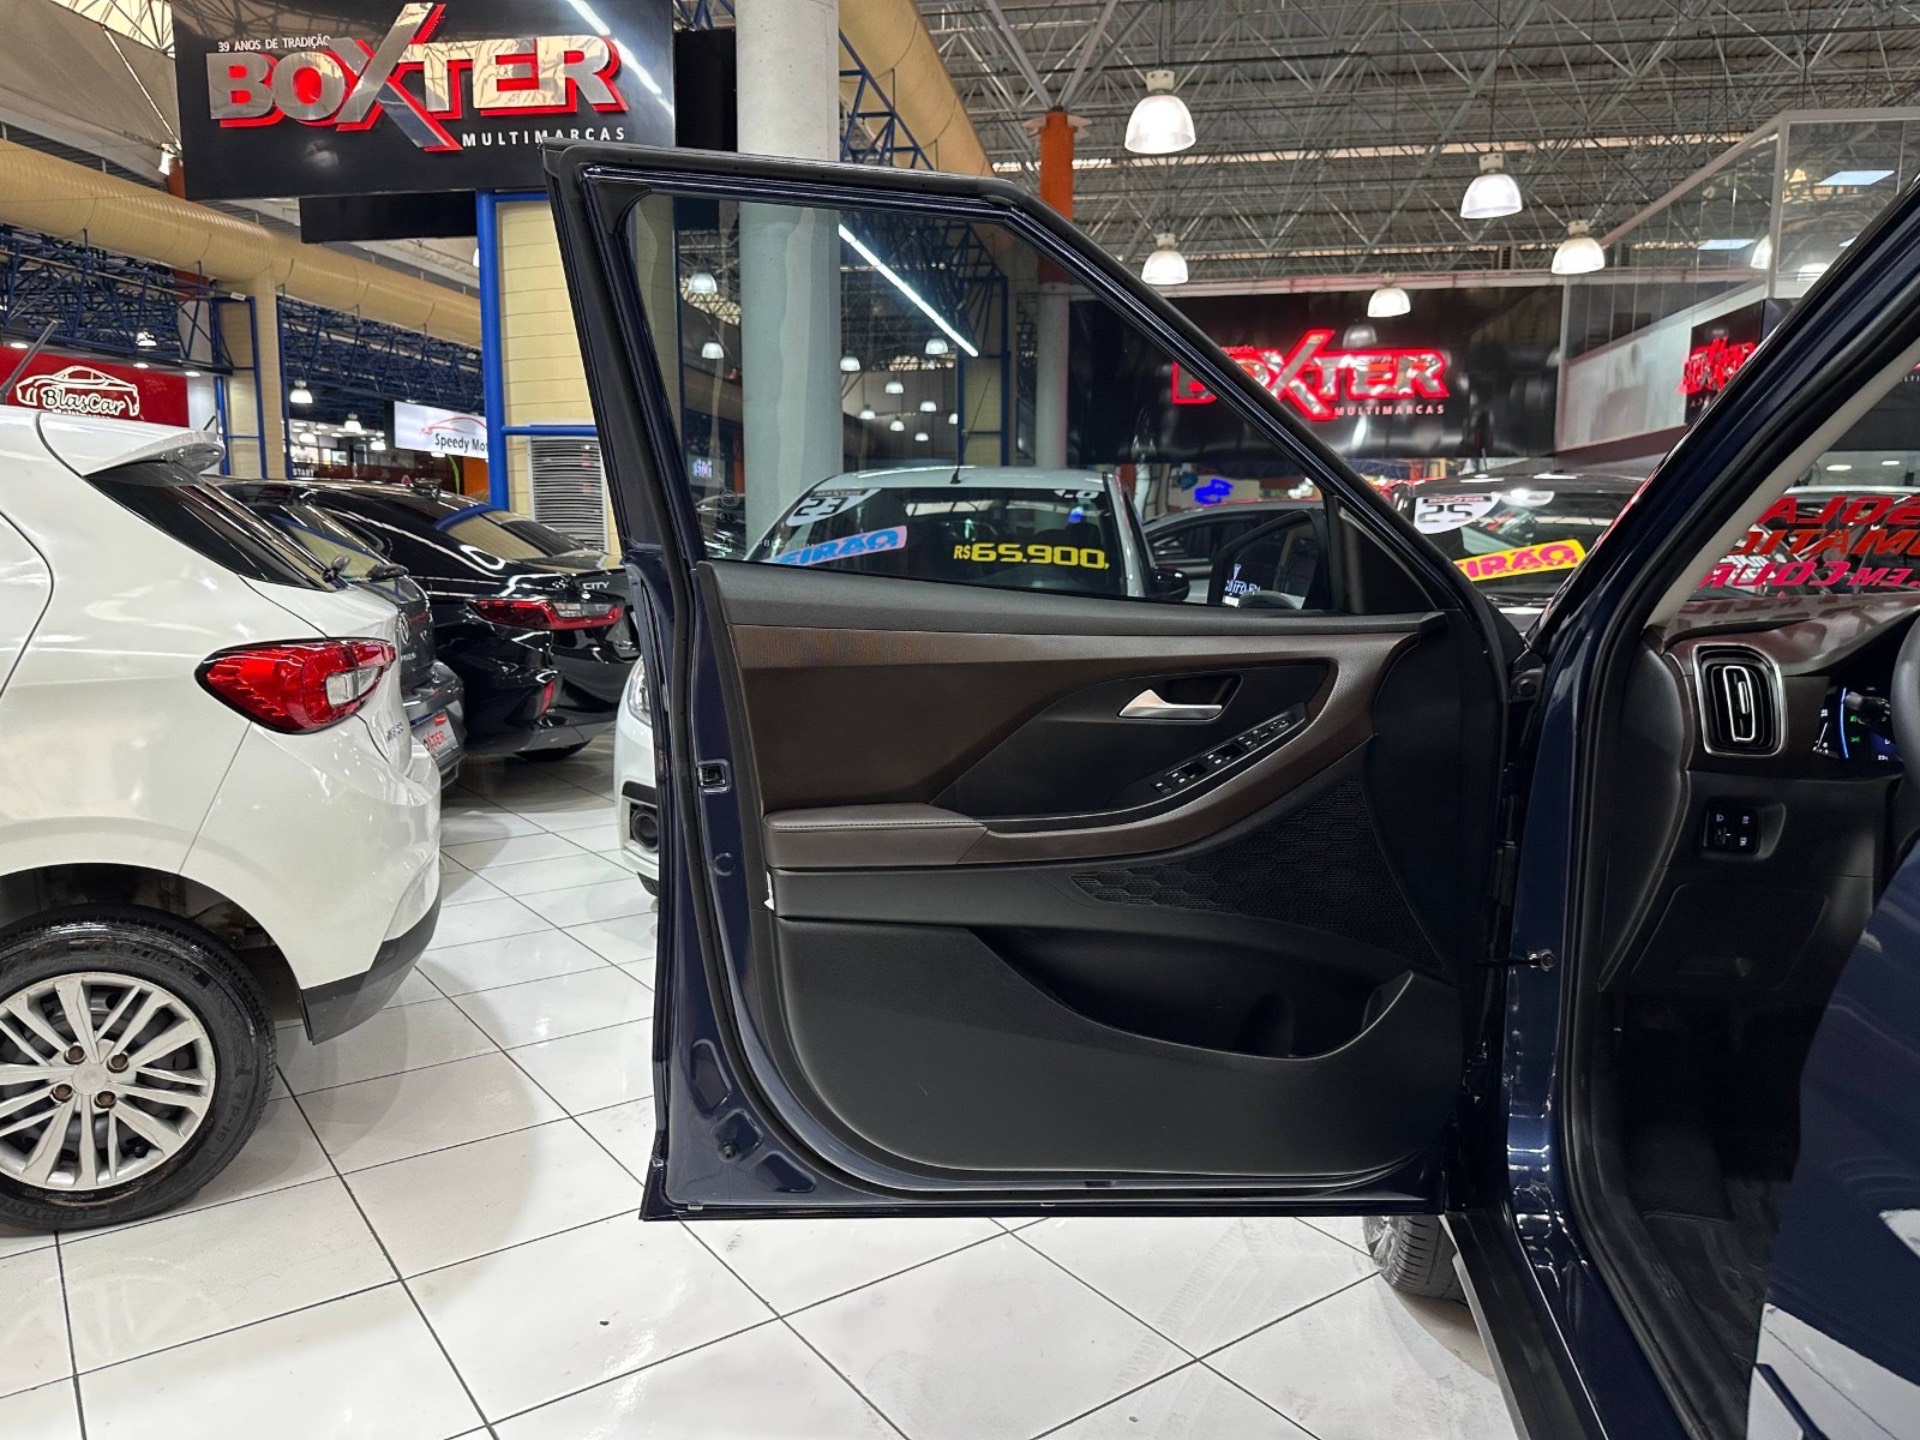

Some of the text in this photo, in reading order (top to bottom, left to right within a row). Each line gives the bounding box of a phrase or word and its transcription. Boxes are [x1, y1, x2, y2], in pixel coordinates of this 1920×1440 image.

[218, 33, 331, 53] 39 ANOS DE TRADIÇÃO
[206, 2, 628, 152] BOXTER
[462, 126, 625, 148] MULTIMARCAS
[41, 387, 126, 416] BlasCar
[1334, 404, 1445, 416] MULTIMARCAS
[435, 433, 488, 453] Speedy Mo
[793, 497, 849, 517] 23
[1417, 503, 1473, 523] 25
[582, 581, 610, 590] CITY
